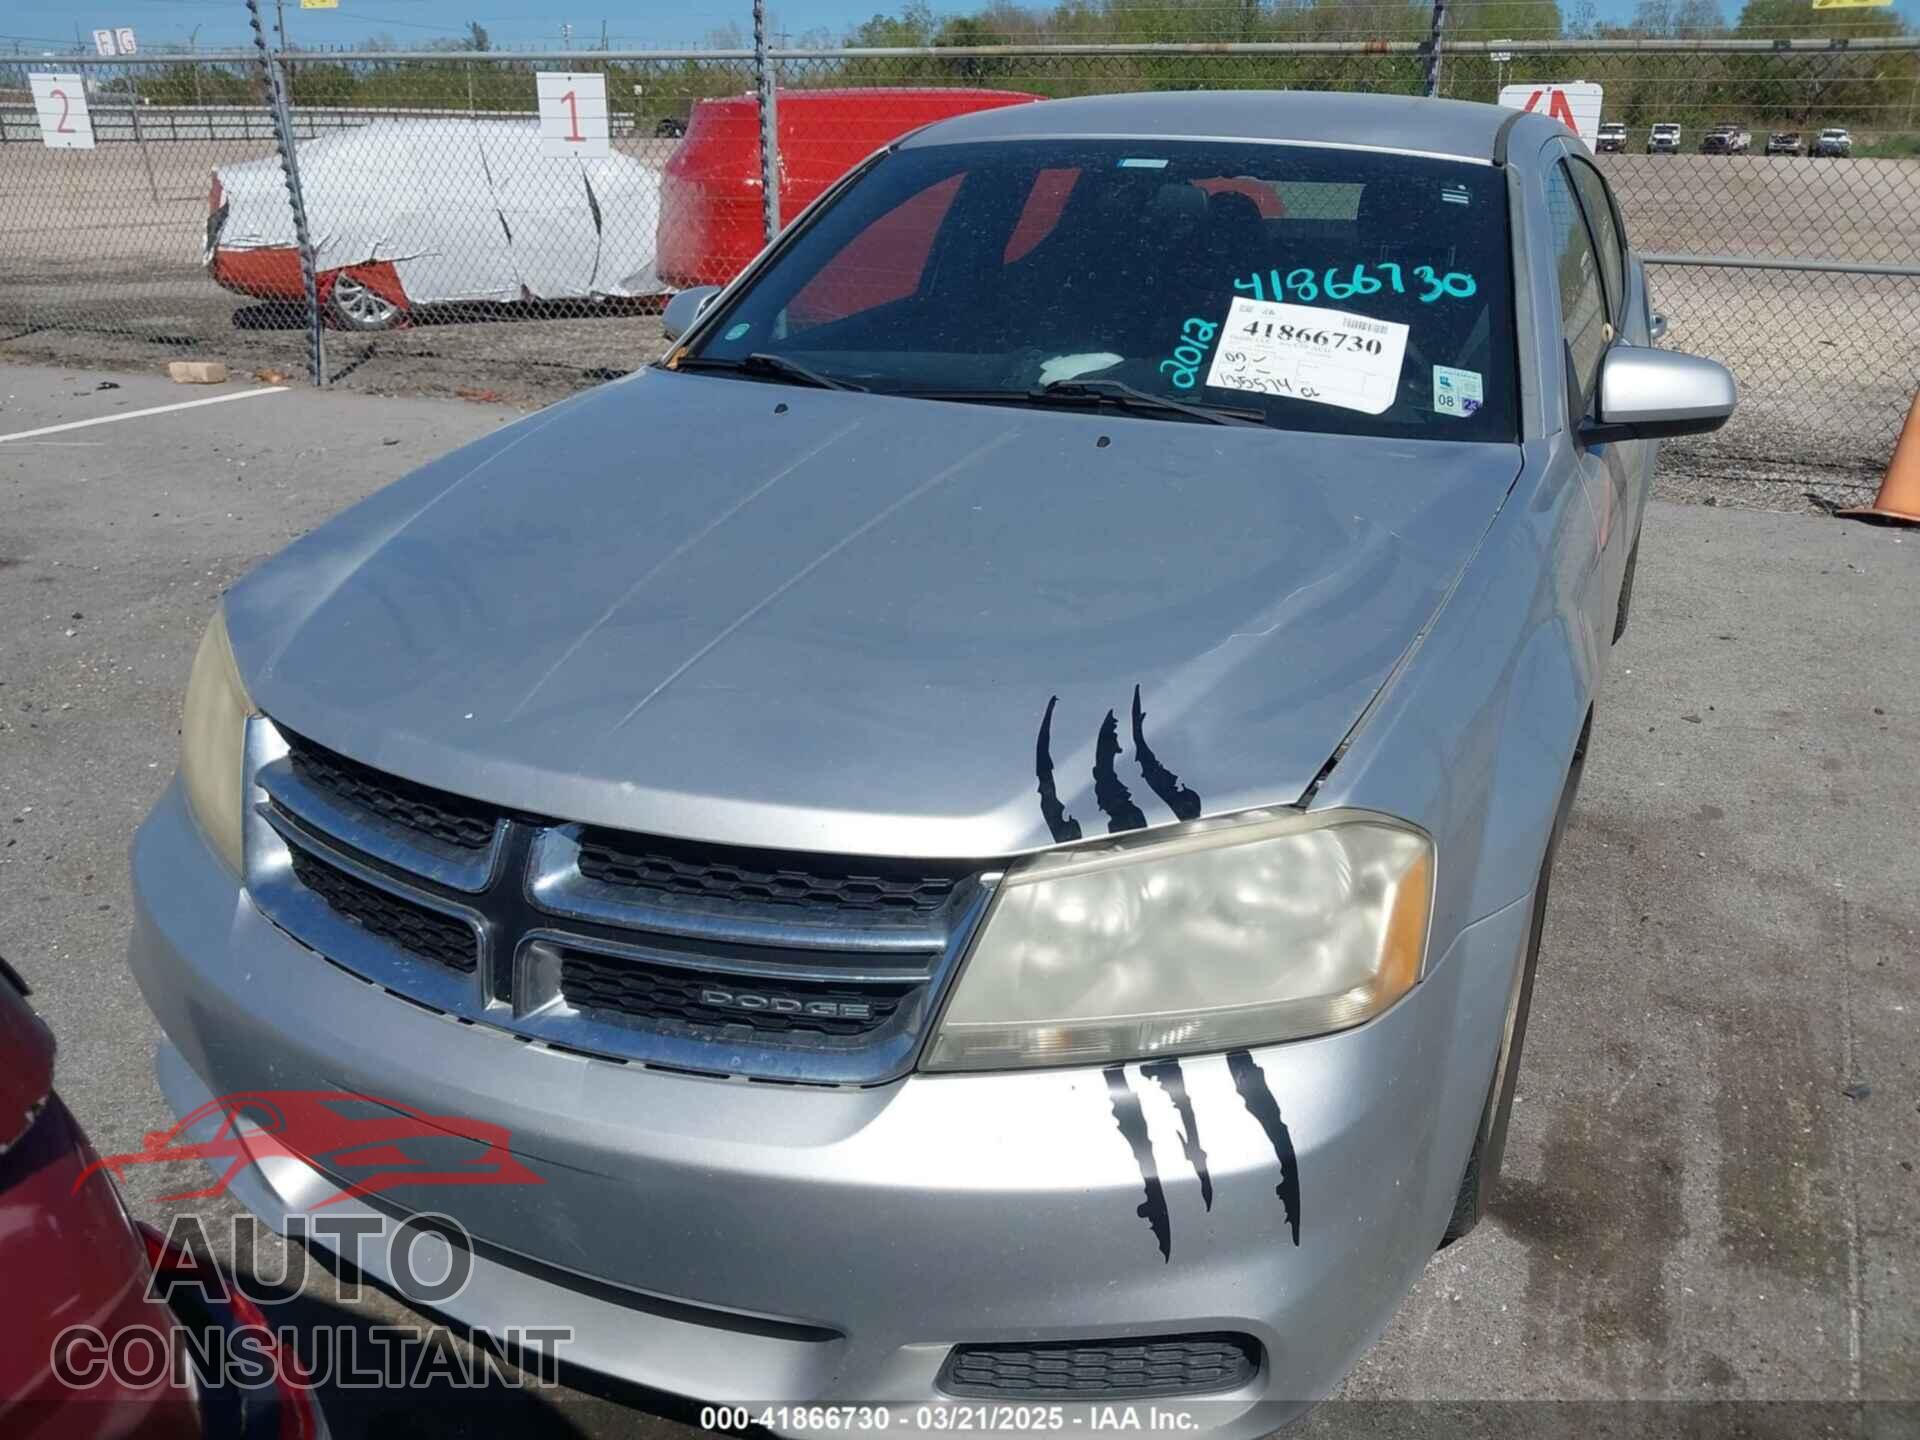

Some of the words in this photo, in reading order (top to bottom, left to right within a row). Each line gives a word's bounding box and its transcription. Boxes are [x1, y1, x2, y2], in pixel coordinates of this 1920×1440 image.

[50, 89, 76, 133] 2
[561, 90, 586, 141] 1
[1233, 262, 1477, 302] 41866730
[1159, 317, 1219, 389] 2012
[1243, 320, 1382, 357] 41866730
[1438, 394, 1454, 408] 08
[702, 989, 870, 1018] DODGE
